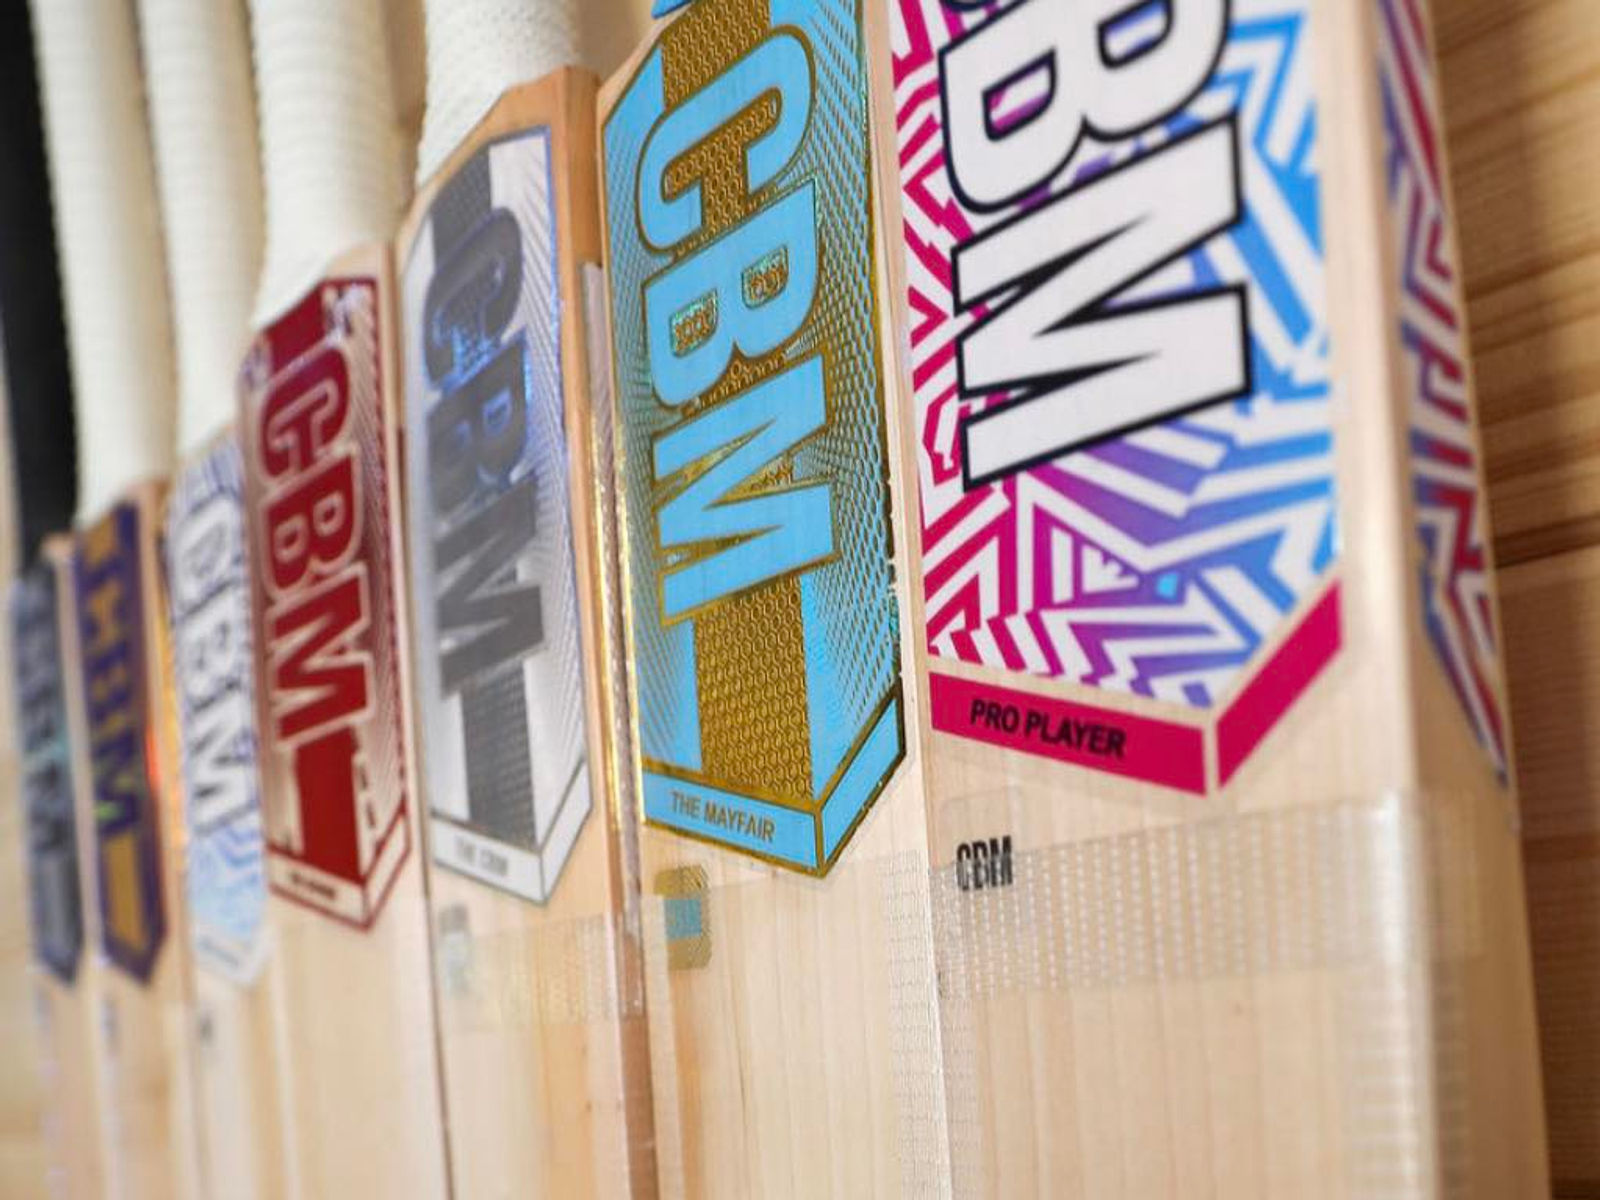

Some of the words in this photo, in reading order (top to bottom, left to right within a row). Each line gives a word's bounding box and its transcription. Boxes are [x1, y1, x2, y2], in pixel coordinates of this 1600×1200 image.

[421, 205, 548, 698] CBM
[636, 25, 842, 627] CBM
[938, 0, 1254, 493] BM
[258, 345, 370, 742] CBM
[970, 699, 1020, 734] PRO
[1024, 710, 1127, 760] PLAYER
[671, 790, 699, 819] THE
[704, 799, 776, 844] MAYFAIR
